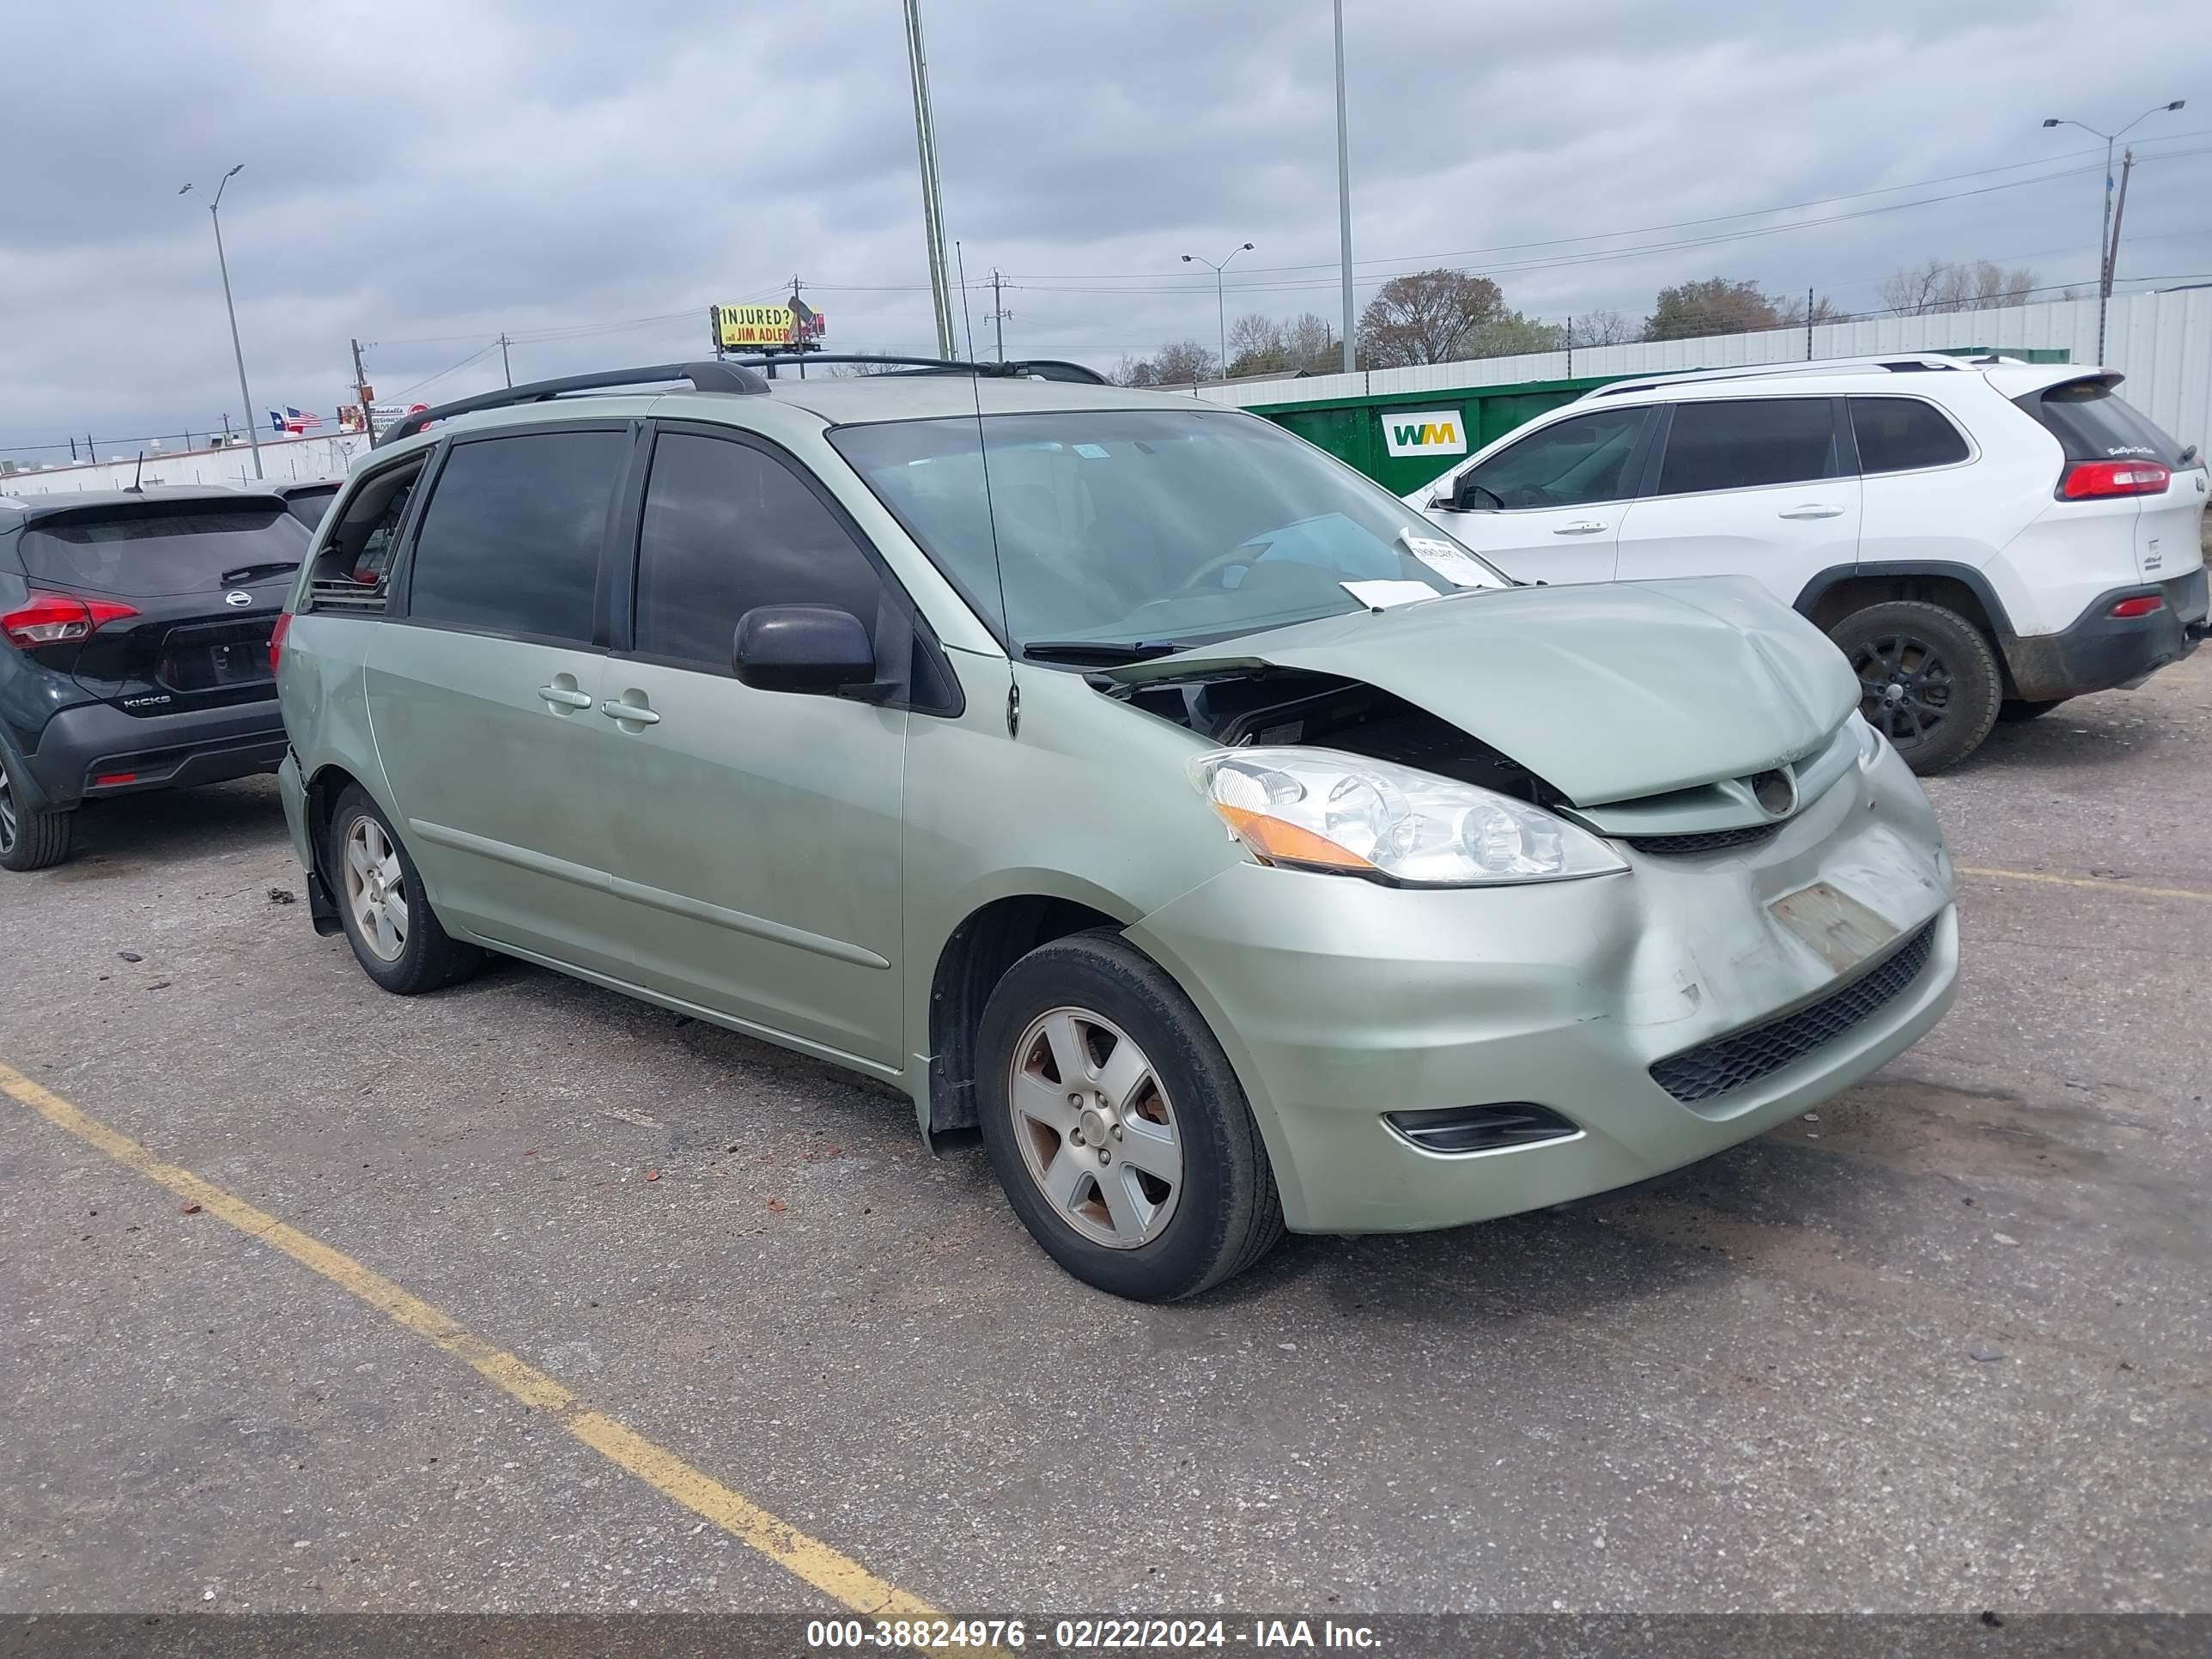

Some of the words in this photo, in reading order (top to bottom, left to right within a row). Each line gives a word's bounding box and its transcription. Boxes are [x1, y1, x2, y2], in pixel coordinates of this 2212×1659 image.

[722, 308, 790, 325] INJURED?
[737, 327, 756, 342] JIM
[759, 327, 790, 342] ADLER
[1393, 422, 1457, 447] WM
[124, 696, 172, 708] KICKS
